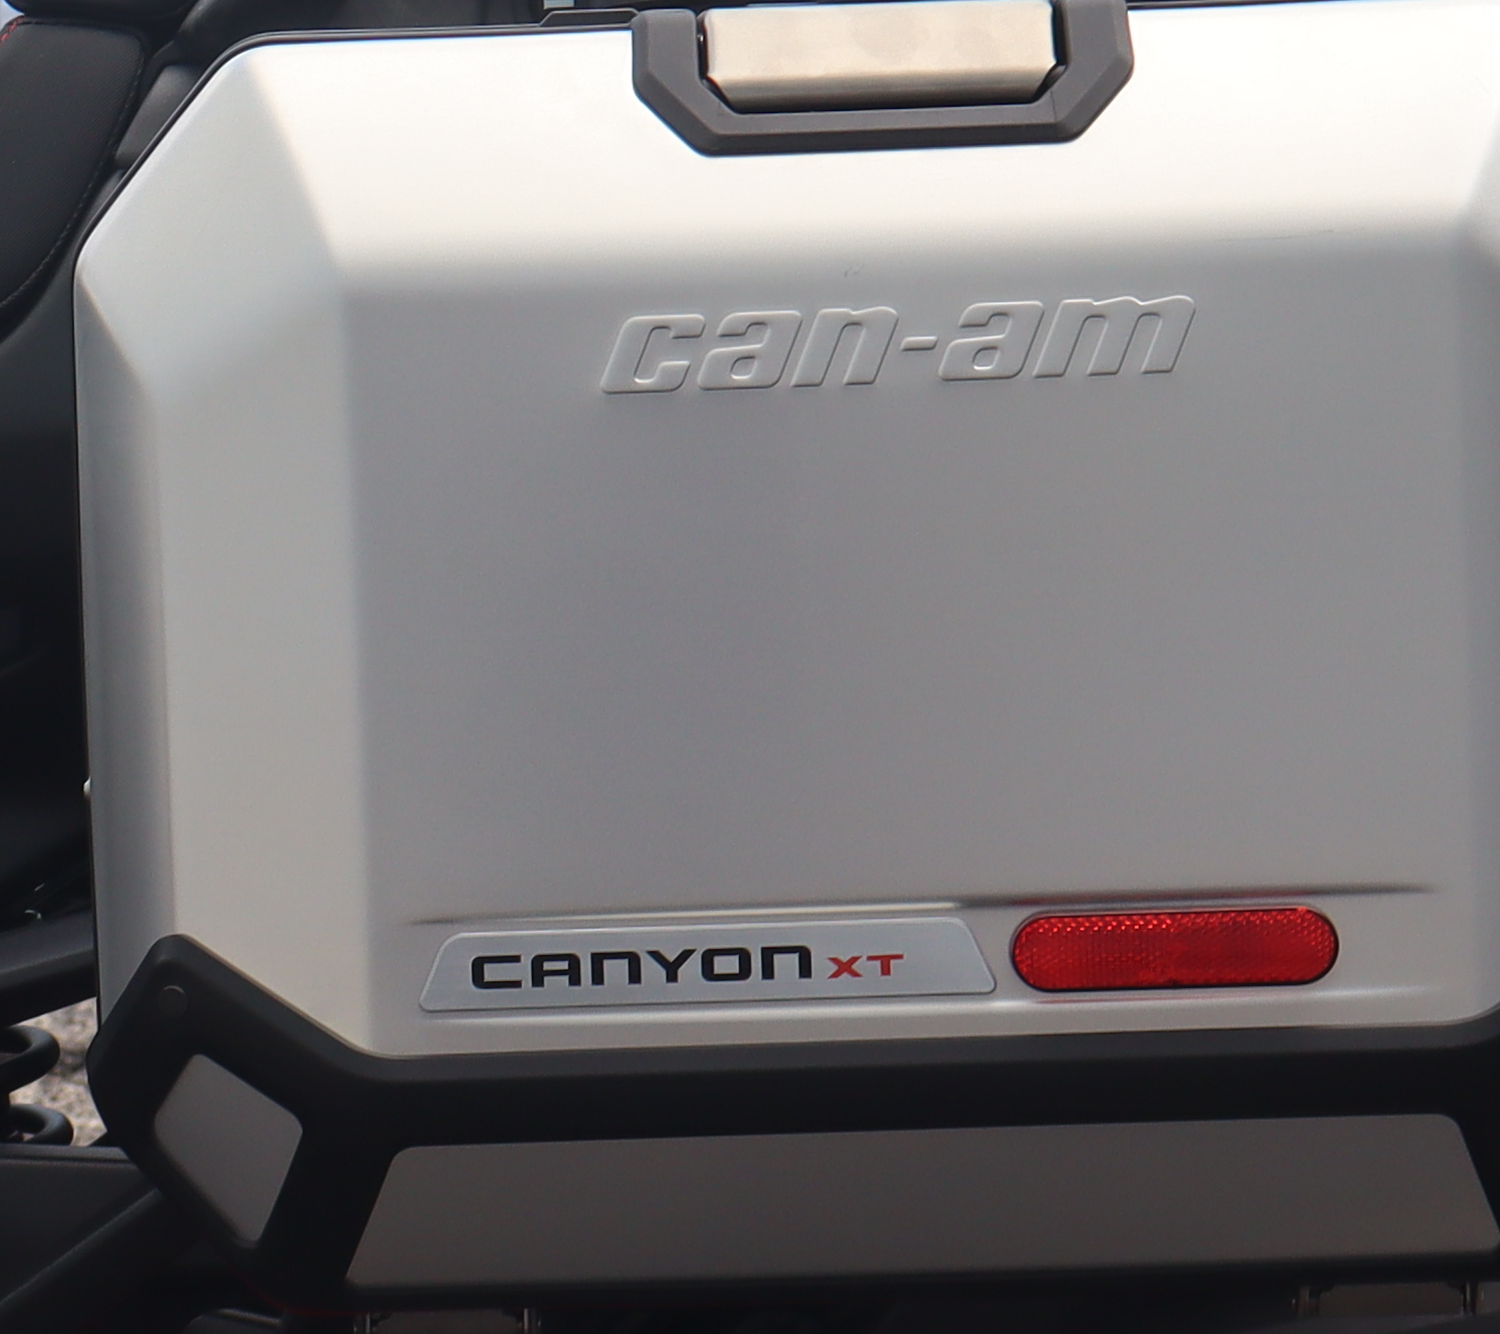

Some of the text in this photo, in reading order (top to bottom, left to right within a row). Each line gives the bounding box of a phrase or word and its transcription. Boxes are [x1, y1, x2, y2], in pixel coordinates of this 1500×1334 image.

[600, 295, 1197, 395] can-am
[470, 945, 905, 990] CANYON XT
